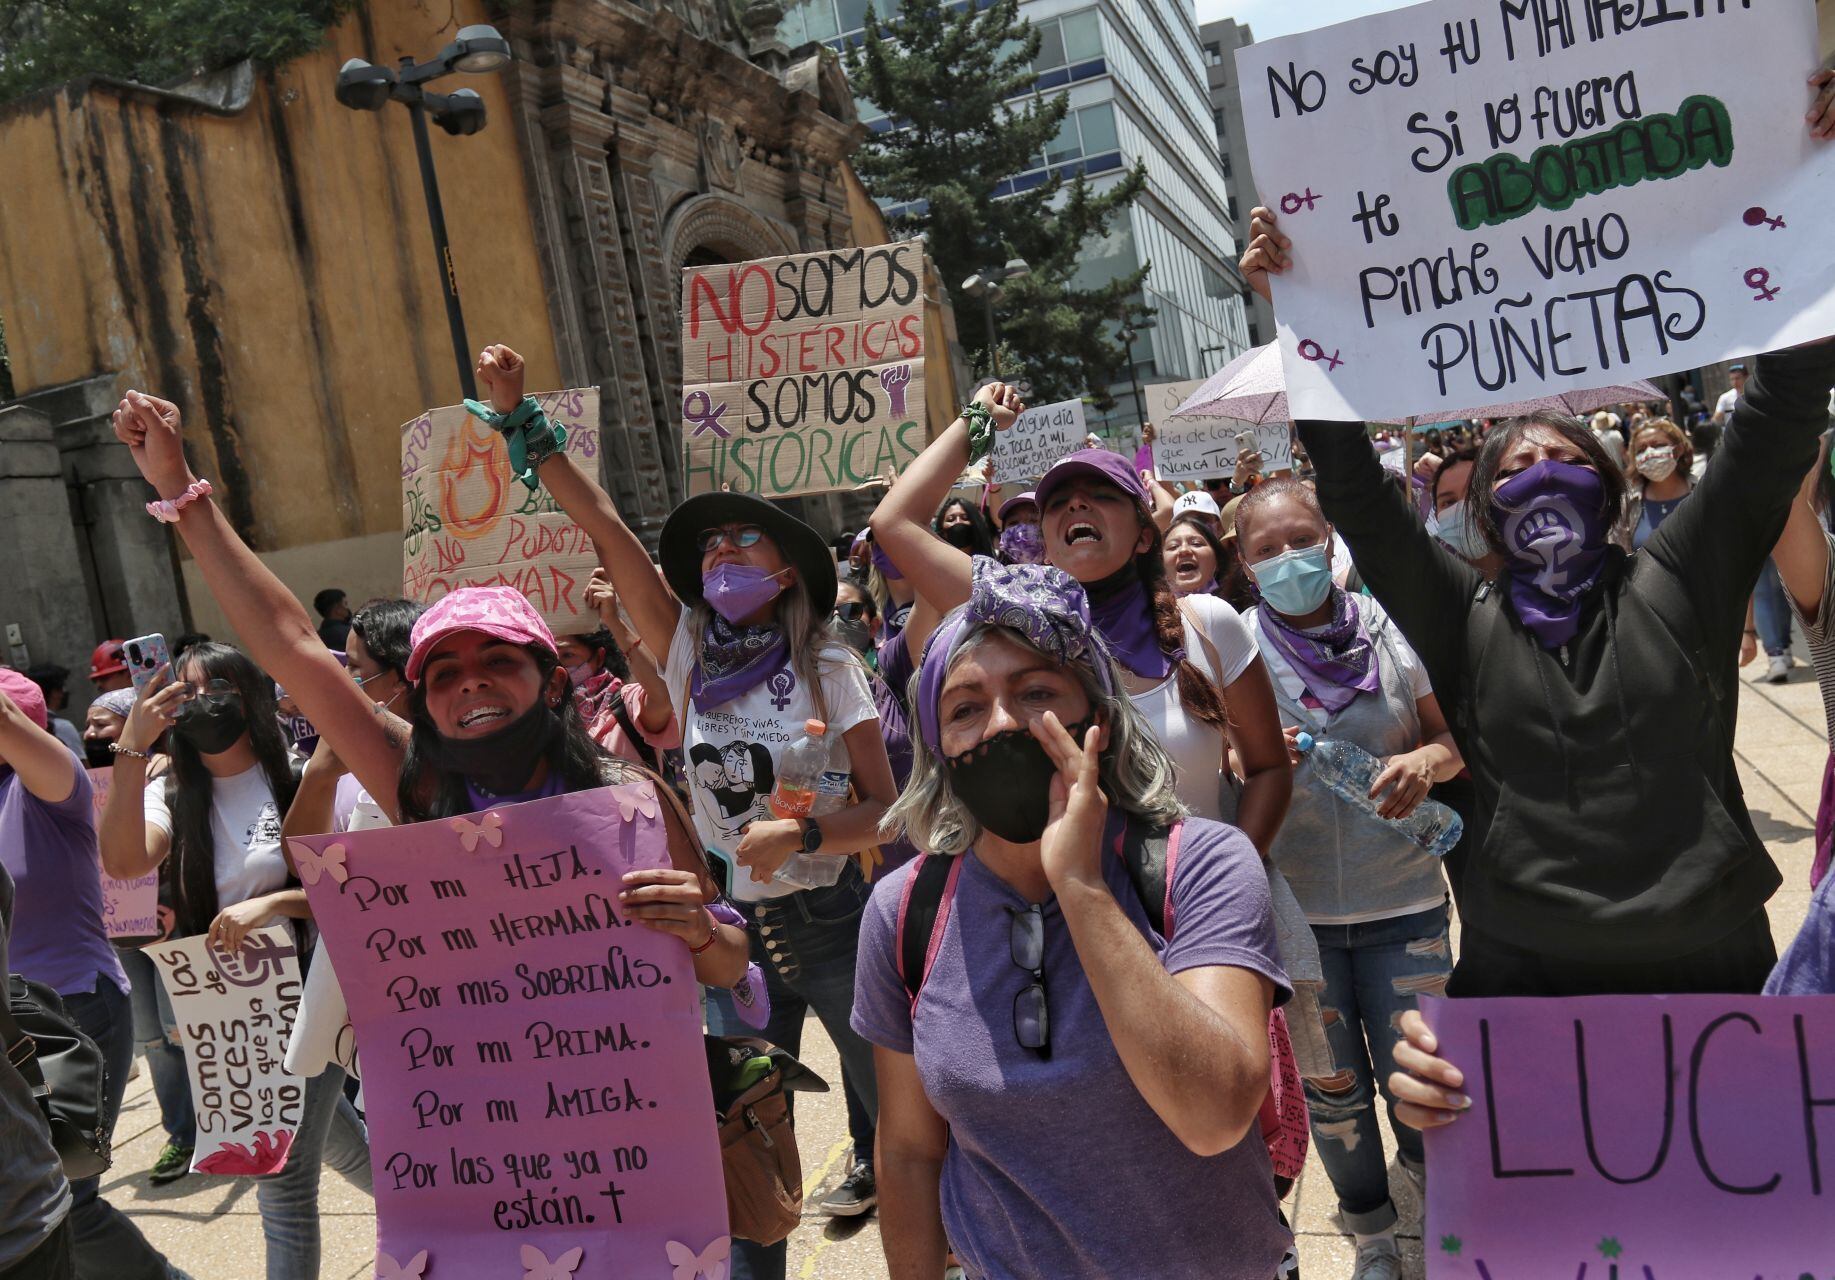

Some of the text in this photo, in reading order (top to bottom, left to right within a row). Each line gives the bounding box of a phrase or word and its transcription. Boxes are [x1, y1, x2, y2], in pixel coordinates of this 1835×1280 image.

[1267, 61, 1326, 118] No
[1349, 43, 1418, 95] soy
[1406, 110, 1464, 172] Si
[1530, 70, 1642, 140] fuera
[1352, 102, 1725, 244] te ABORTABA
[690, 246, 918, 339] NO SOMOS
[707, 315, 921, 386] HISTÉRICAS
[1421, 269, 1705, 396] PUÑETAS
[746, 370, 878, 433] SOMOS
[686, 424, 921, 495] HISTÓRICAS
[1161, 460, 1208, 474] NUNCA
[434, 536, 466, 573] NO
[499, 517, 595, 564] PUDISTE
[733, 726, 739, 735] Y
[339, 845, 602, 912] Por mi HIJA.
[365, 928, 426, 963] Por
[442, 928, 479, 951] mi
[387, 975, 441, 1013] Por
[457, 979, 509, 1006] mis
[159, 950, 226, 1133] Somos las
[204, 969, 253, 1132] voces de
[249, 997, 279, 1126] las que ya
[400, 1027, 456, 1071] Por
[477, 1040, 512, 1063] mi
[525, 1021, 651, 1060] PRIMA.
[278, 1085, 301, 1127] no
[412, 1078, 658, 1129] Por mi AMIGA.
[385, 1144, 648, 1190] Por las que ya no
[493, 1186, 595, 1230] están.
